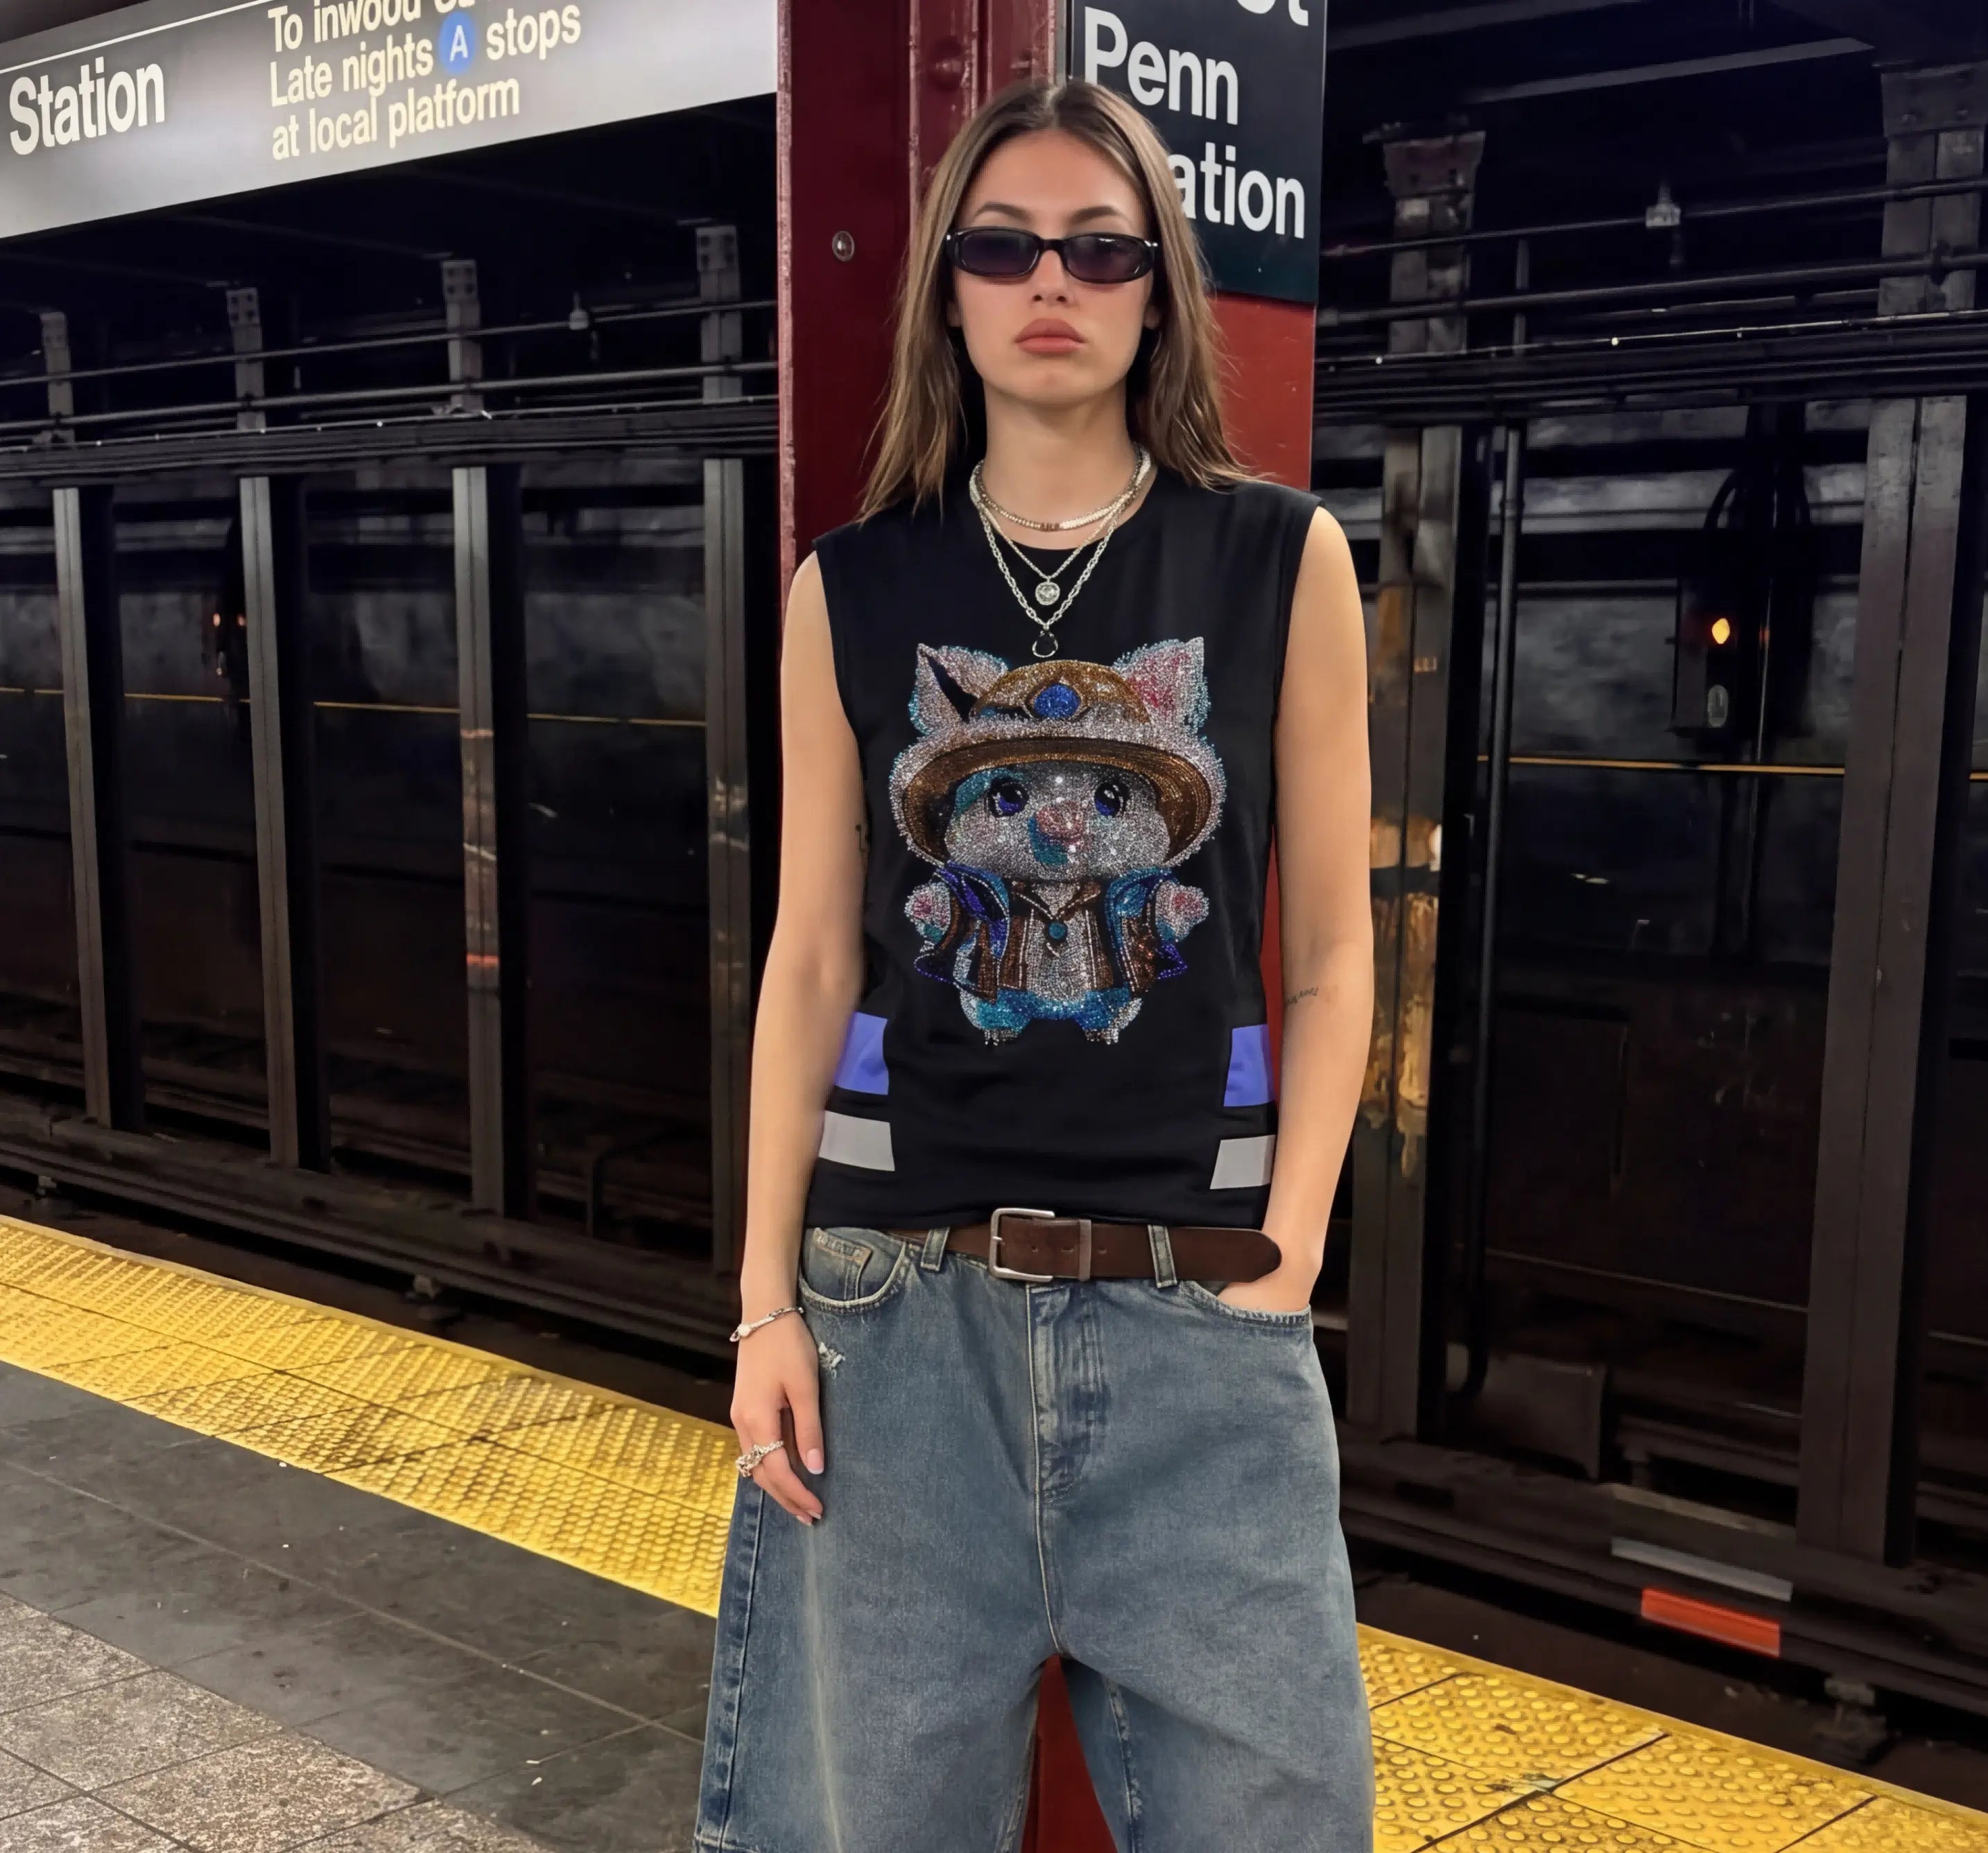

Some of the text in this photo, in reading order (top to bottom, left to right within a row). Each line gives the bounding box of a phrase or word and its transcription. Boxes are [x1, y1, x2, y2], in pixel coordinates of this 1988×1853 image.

[268, 6, 303, 52] To
[270, 4, 581, 107] Late nights A stops
[1084, 6, 1238, 125] Penn
[10, 56, 165, 155] Station
[273, 78, 520, 160] at local platform
[1167, 142, 1305, 238] ation
